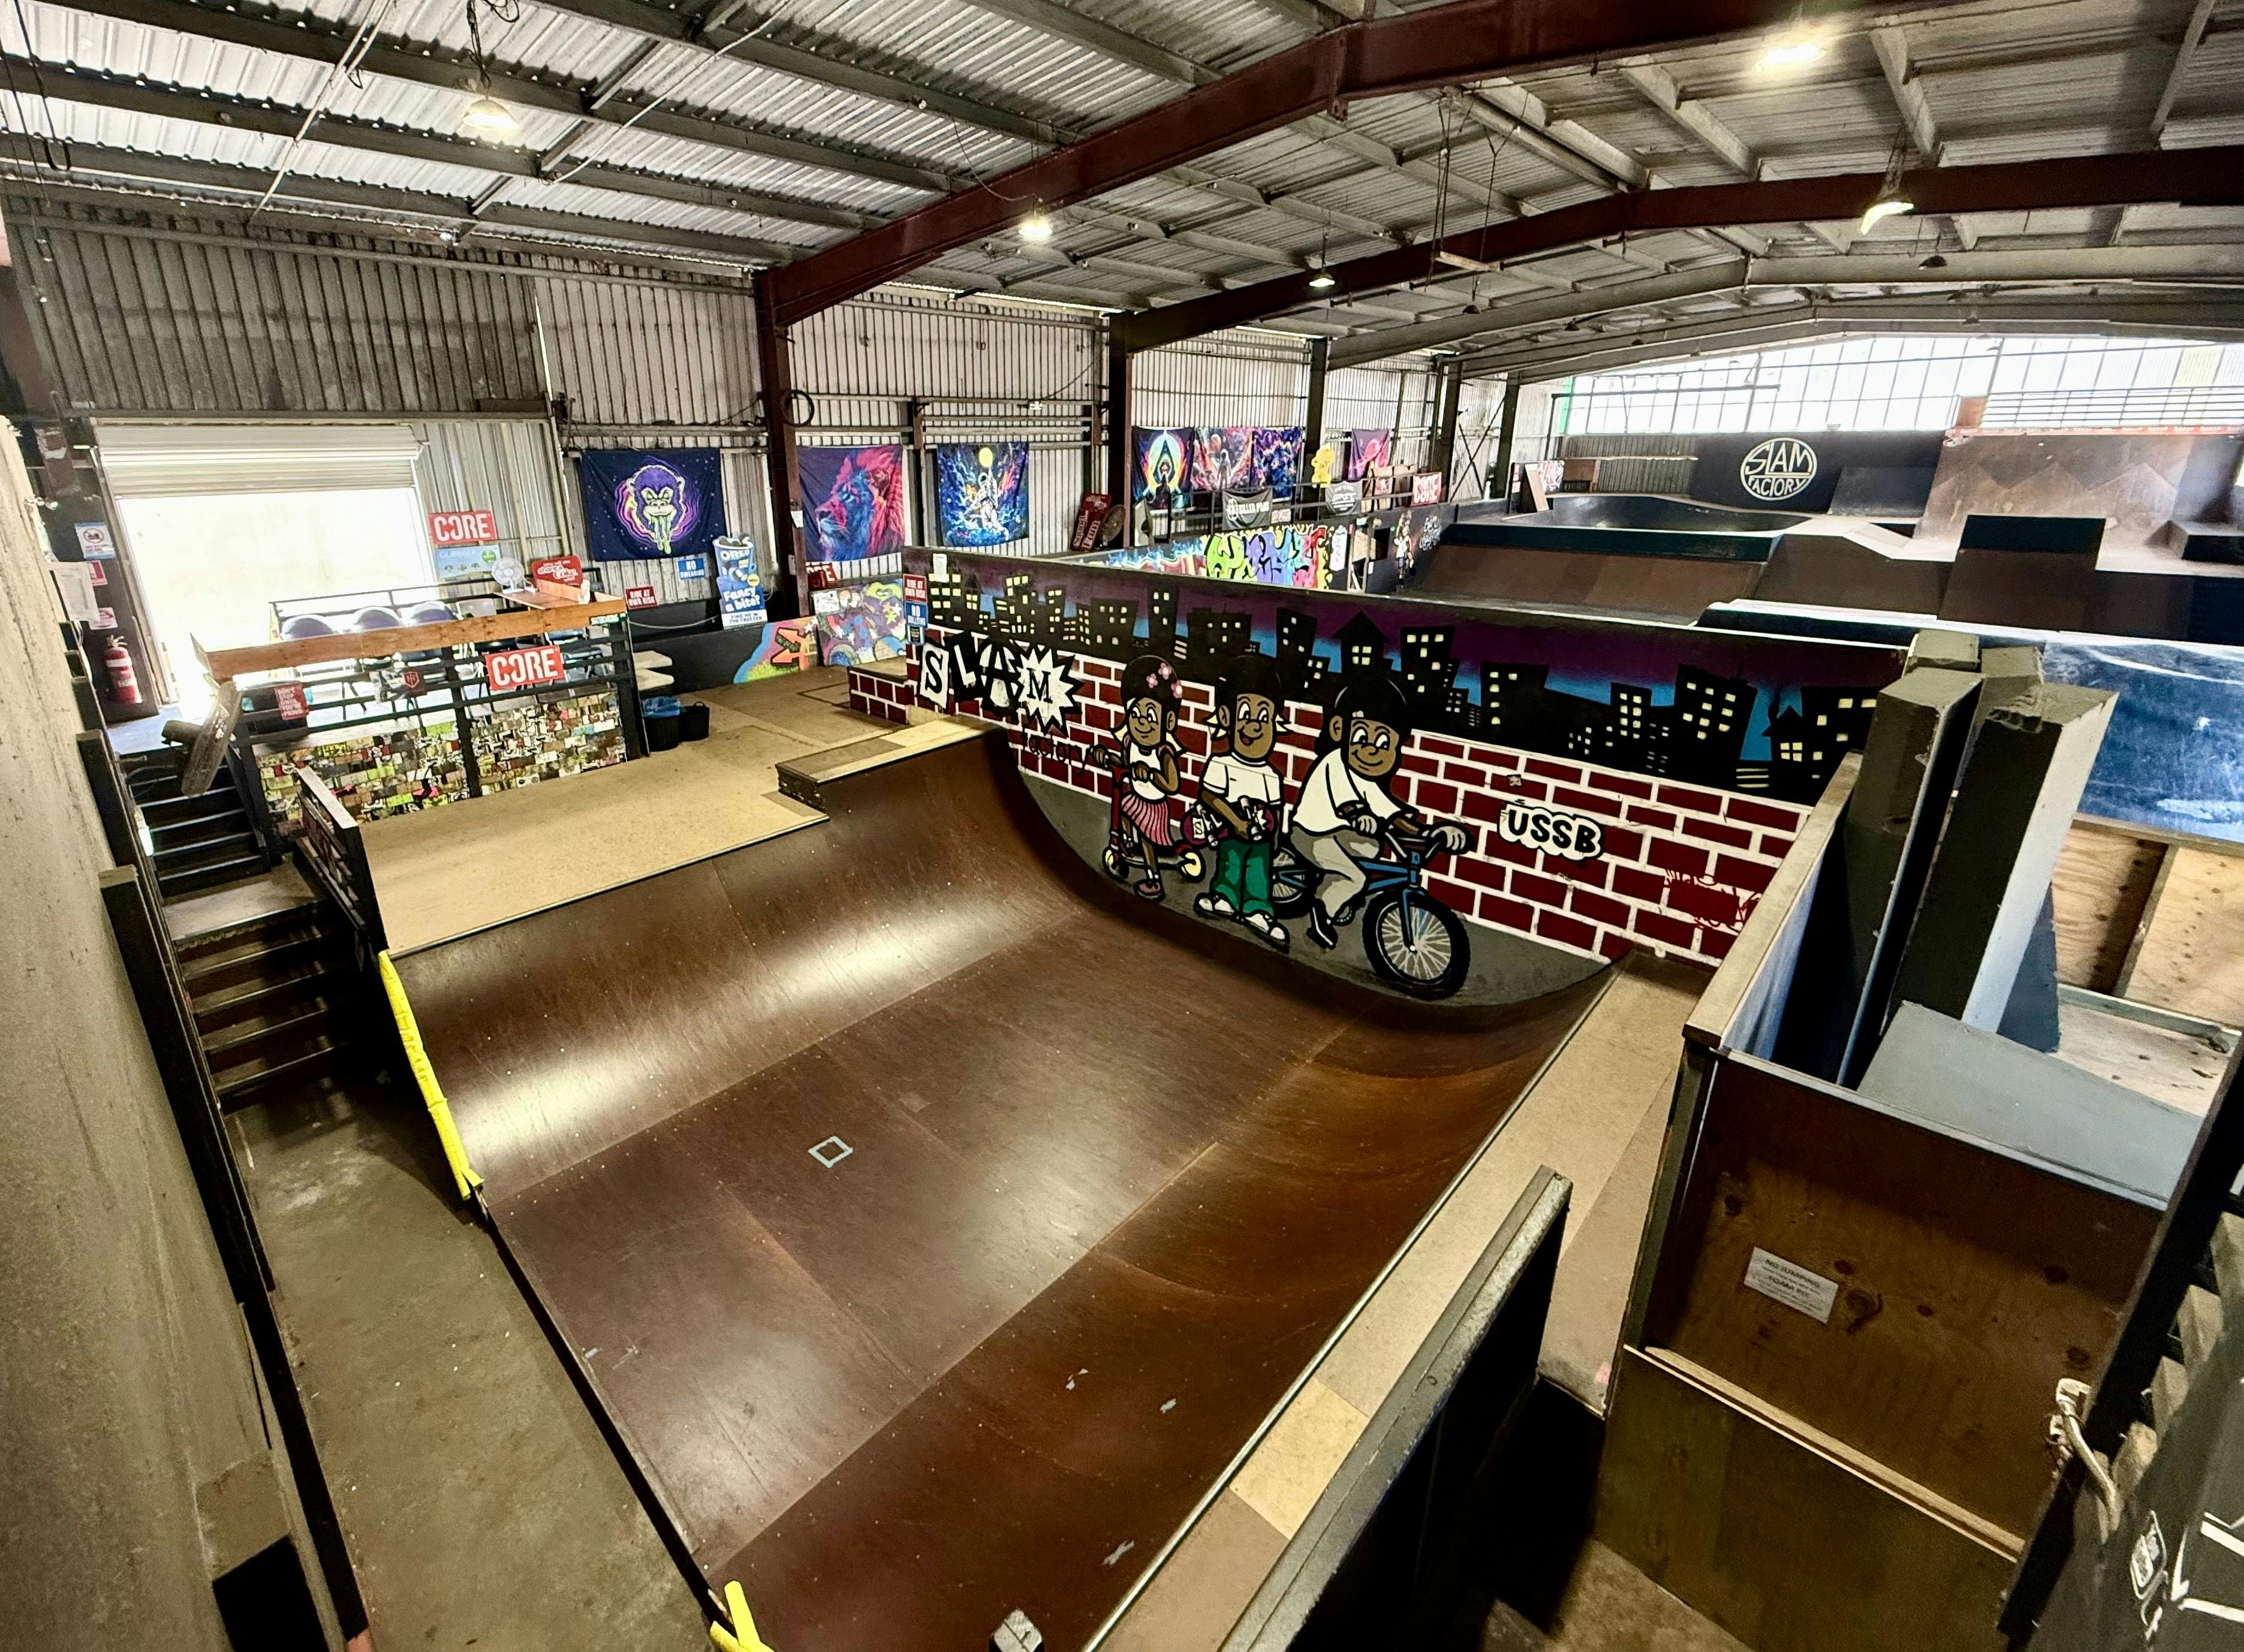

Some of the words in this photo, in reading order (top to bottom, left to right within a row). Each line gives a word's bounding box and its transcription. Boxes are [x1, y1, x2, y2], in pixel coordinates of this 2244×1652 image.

[1745, 442, 1812, 475] SLAM
[1748, 475, 1809, 497] FACTORY
[434, 514, 492, 542] CORE
[720, 550, 750, 560] OREO
[686, 560, 697, 571] NO
[629, 598, 642, 606] OWN
[642, 596, 655, 605] RISK
[630, 590, 643, 598] RIDE
[724, 587, 755, 601] Fancy
[725, 604, 734, 612] a
[734, 595, 760, 610] bite?
[911, 605, 921, 617] NO
[492, 649, 559, 686] CORE
[922, 640, 1058, 710] SLAM
[1508, 809, 1596, 854] USSB
[1766, 1259, 1780, 1269] NO
